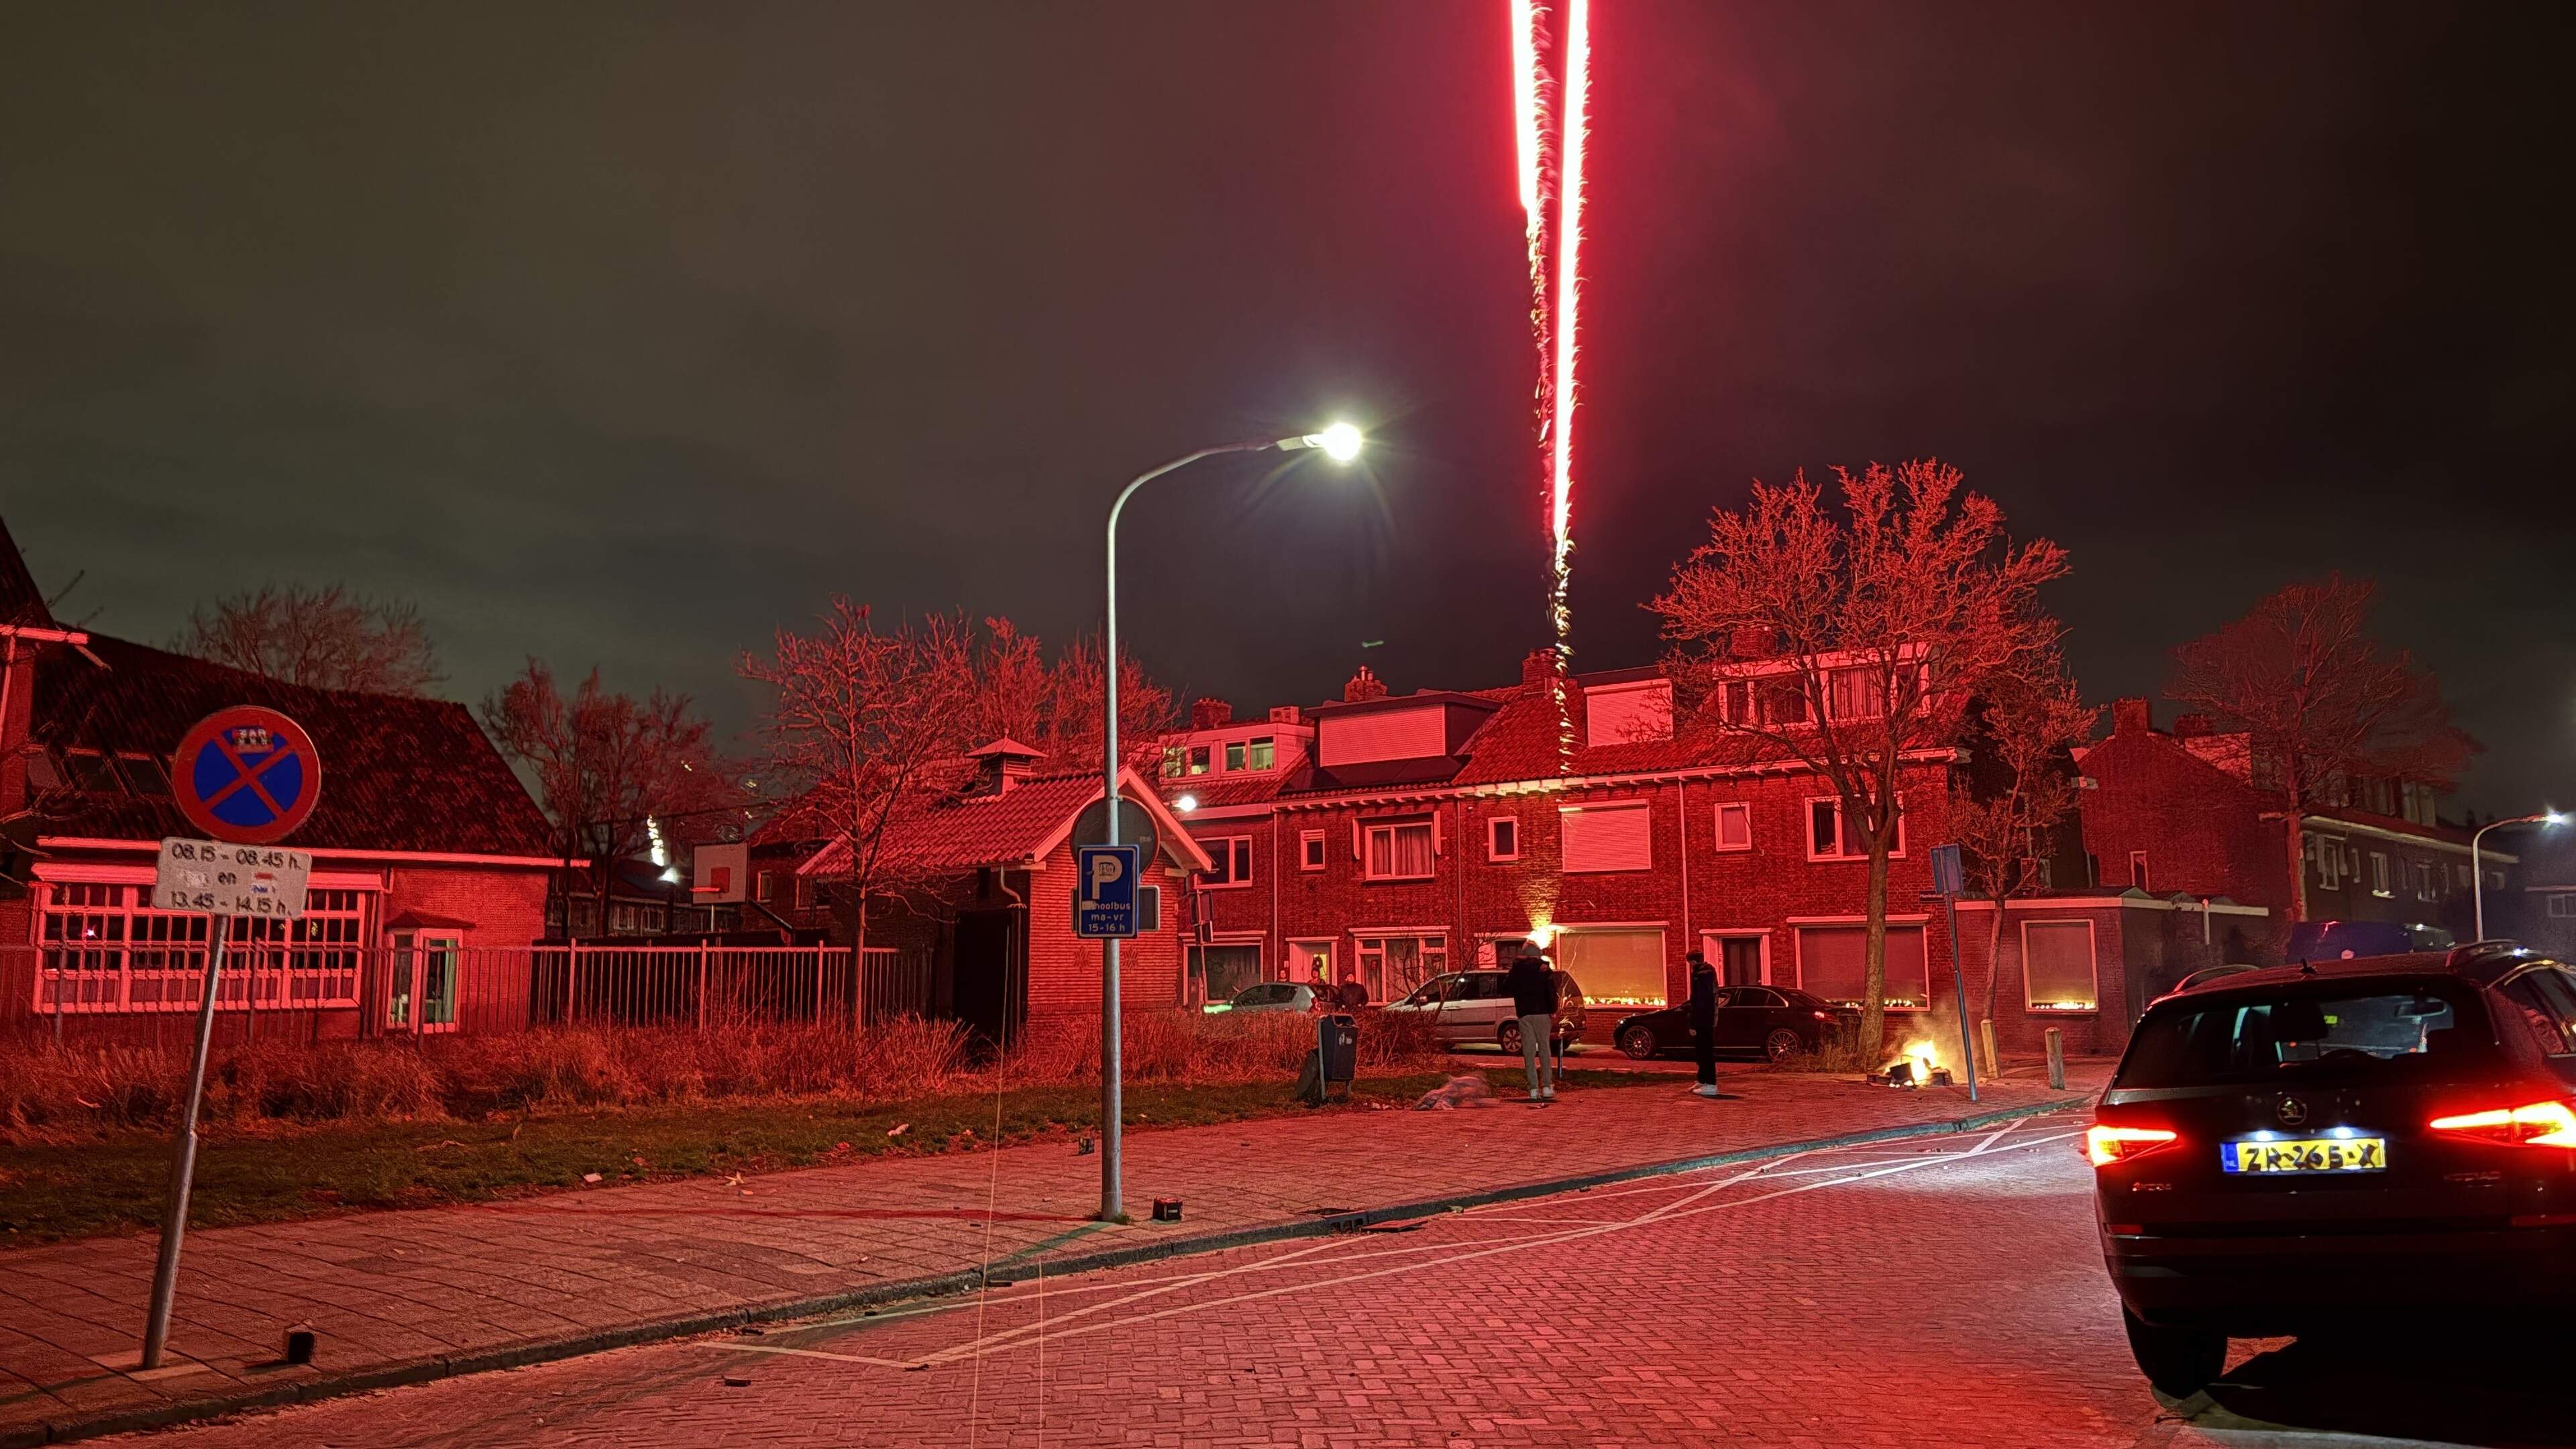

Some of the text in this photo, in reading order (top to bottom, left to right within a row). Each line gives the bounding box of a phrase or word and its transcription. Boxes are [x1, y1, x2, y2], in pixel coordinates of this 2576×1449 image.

[217, 872, 237, 885] en
[1092, 855, 1123, 900] P
[1119, 923, 1126, 932] h
[2245, 1144, 2379, 1171] ZR-265-X
